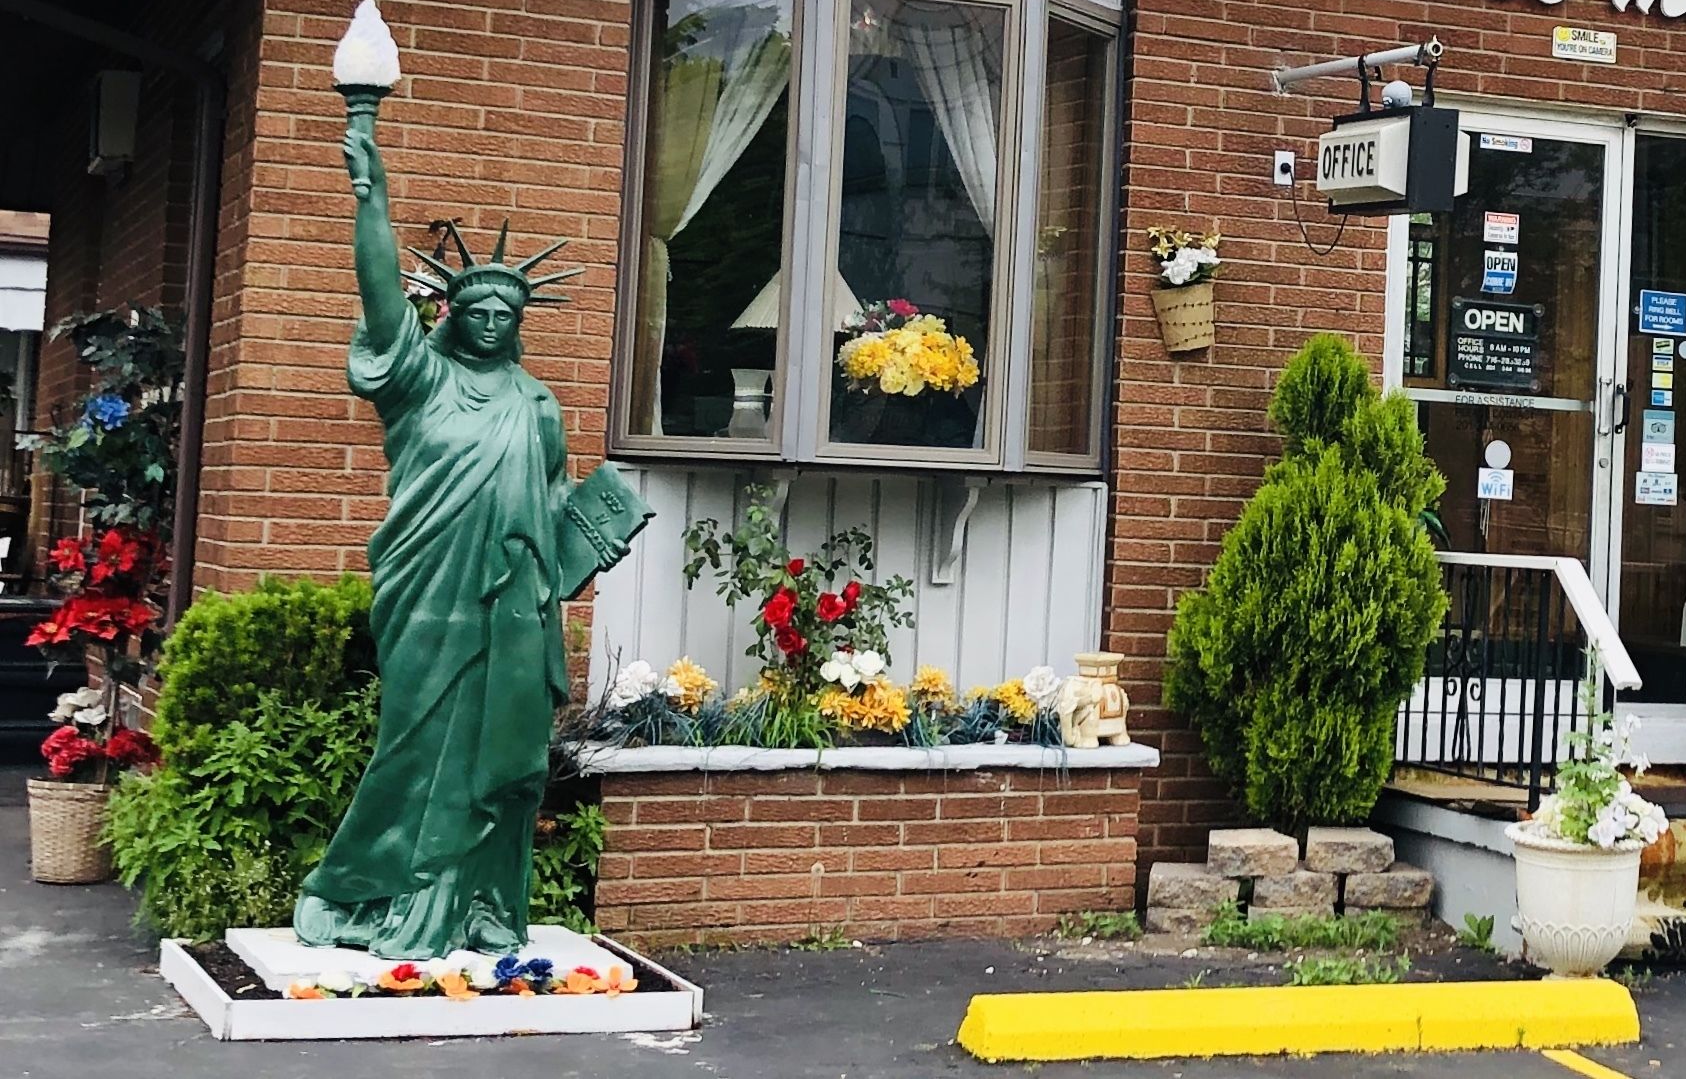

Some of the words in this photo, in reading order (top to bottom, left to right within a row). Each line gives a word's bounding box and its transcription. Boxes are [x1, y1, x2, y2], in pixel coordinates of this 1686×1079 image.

[1571, 29, 1599, 44] SMILE
[1556, 42, 1578, 53] YOU'RE
[1578, 44, 1588, 54] ON
[1588, 45, 1613, 56] CAMERA
[1322, 140, 1376, 180] OFFICE
[1486, 256, 1516, 272] OPEN
[1650, 296, 1678, 307] PLEASE
[1648, 305, 1664, 315] RING
[1665, 306, 1681, 316] BELL
[1464, 308, 1525, 334] OPEN
[1644, 314, 1658, 323] FOR
[1658, 315, 1684, 326] ROOMS
[1457, 337, 1484, 346] OFFICE
[1457, 344, 1485, 354] HOURS
[1457, 353, 1483, 363] PHONE
[1455, 394, 1475, 404] FOR
[1478, 395, 1535, 408] ASSISTANCE
[1481, 482, 1511, 497] WiFi
